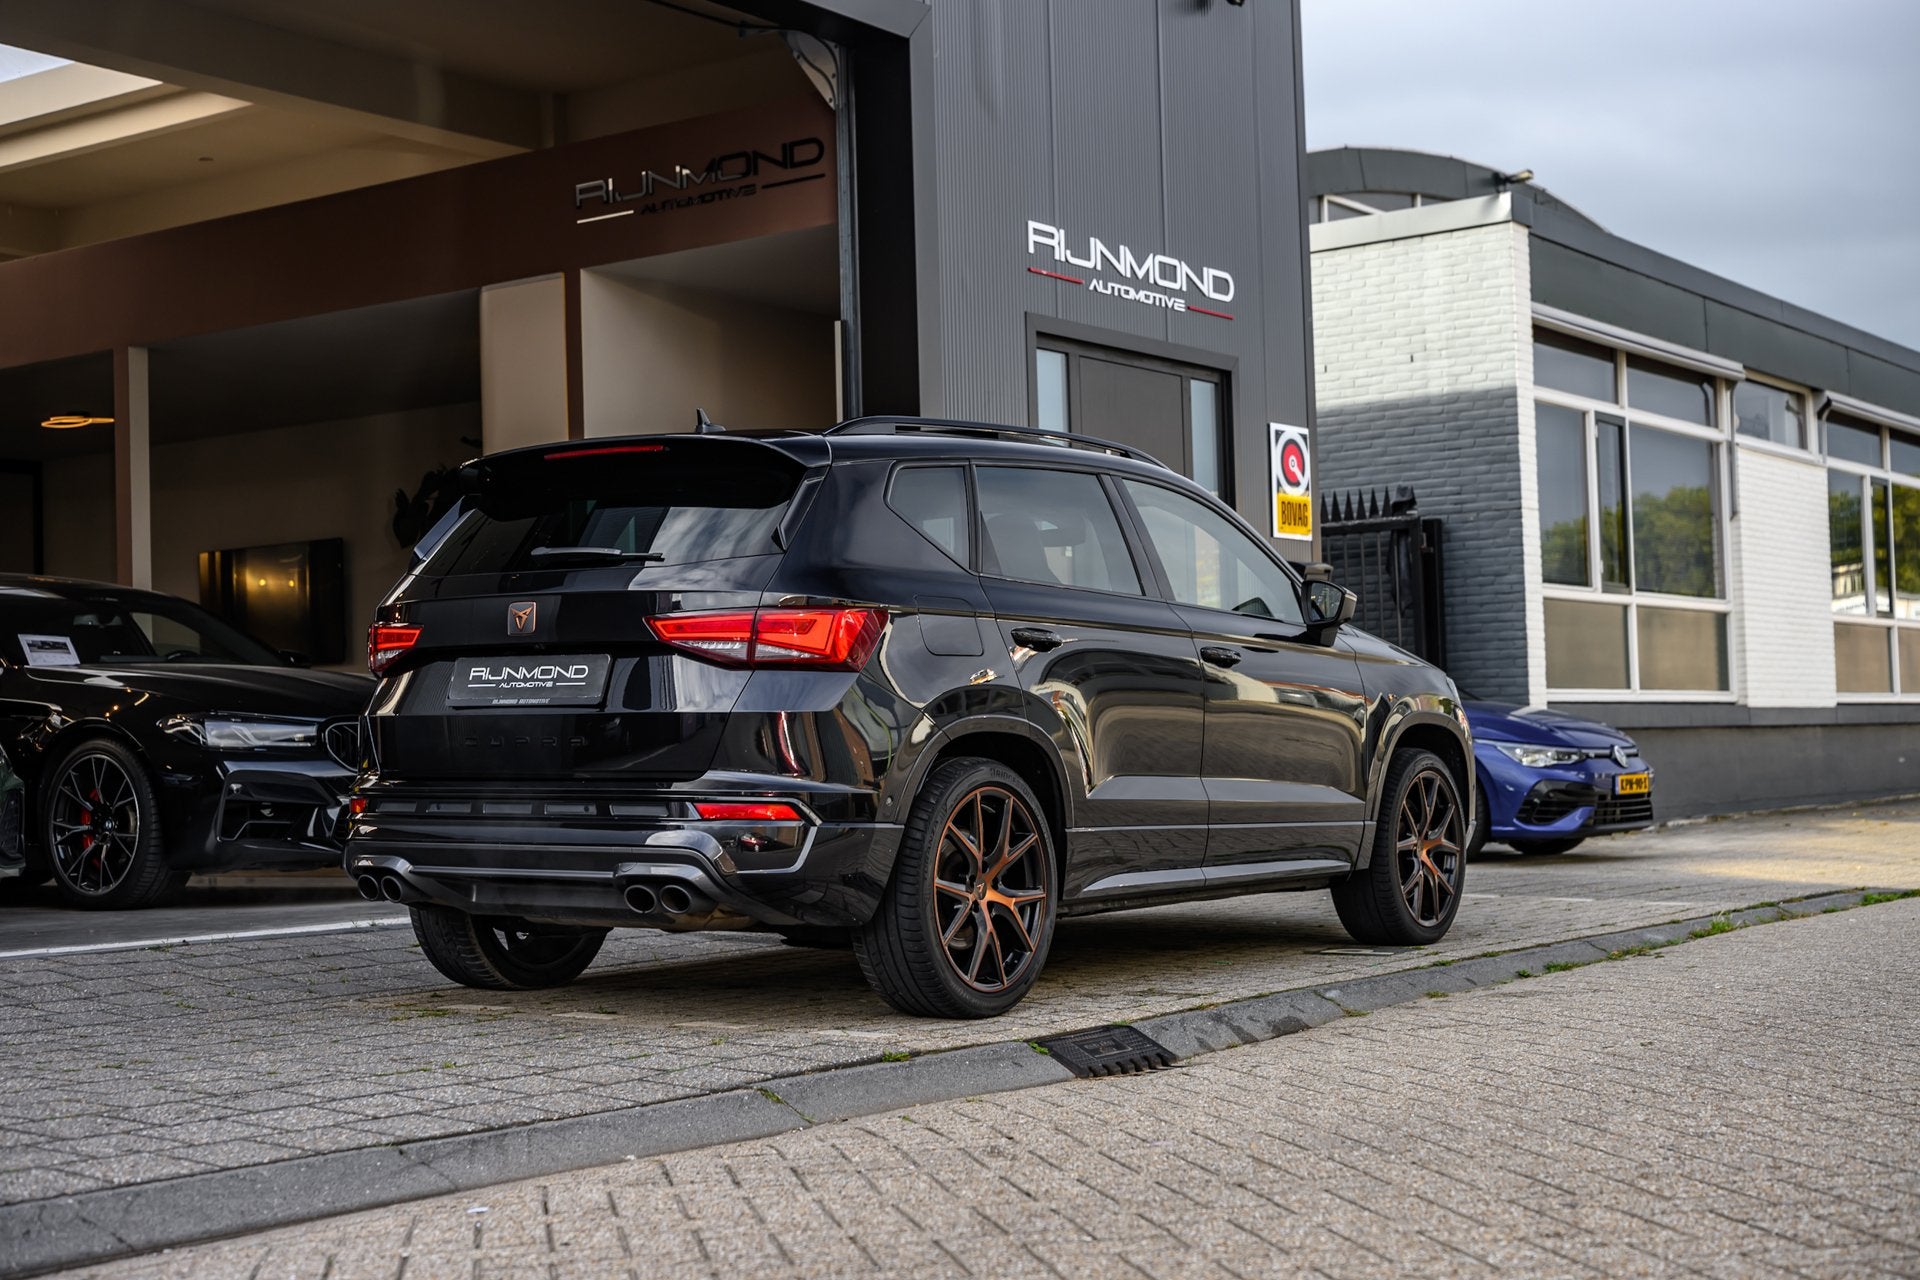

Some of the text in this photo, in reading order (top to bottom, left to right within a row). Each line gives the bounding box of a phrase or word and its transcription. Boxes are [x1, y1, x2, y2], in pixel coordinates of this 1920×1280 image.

[575, 137, 825, 209] RIJNMOND
[640, 183, 757, 215] AUTOMOTIVE
[1028, 220, 1235, 302] RIJNMOND
[1089, 278, 1186, 312] AUTOMOTIVE
[1281, 501, 1308, 527] BOVAG
[469, 665, 588, 681] RIJNMOND
